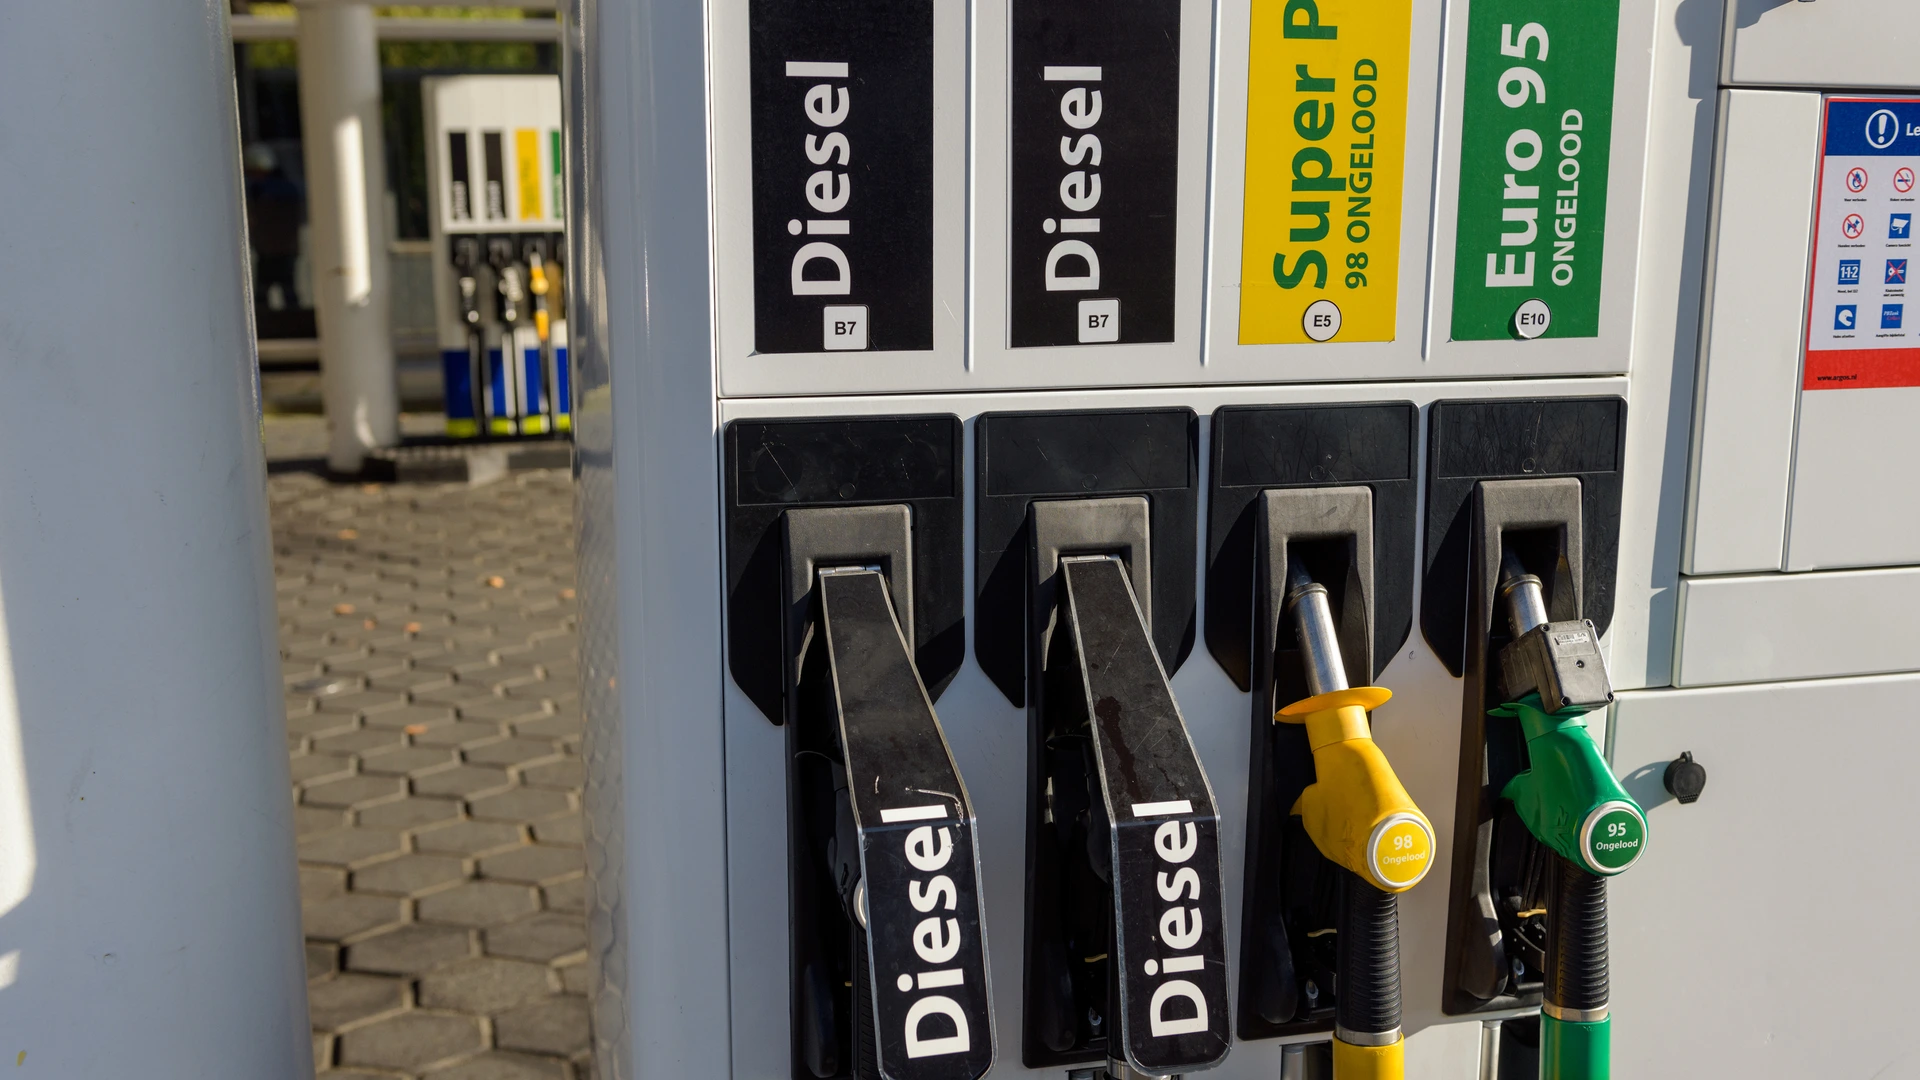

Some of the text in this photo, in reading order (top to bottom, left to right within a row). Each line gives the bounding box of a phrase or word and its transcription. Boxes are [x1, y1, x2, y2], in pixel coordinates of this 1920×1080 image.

[1485, 21, 1550, 288] Euro 95
[785, 61, 850, 296] Diesel
[1043, 65, 1102, 292] Diesel
[1273, 64, 1346, 290] Super
[1345, 58, 1378, 290] 98 ONGELOOD
[1551, 108, 1583, 287] ONGELOOD
[1088, 314, 1109, 329] B7
[1313, 314, 1332, 328] E5
[1520, 313, 1545, 326] E10
[834, 321, 857, 336] B7
[1817, 374, 1857, 382] www.argos.nl
[1607, 822, 1627, 837] 95
[1393, 835, 1413, 851] 98
[1595, 838, 1639, 852] Ongelood
[1382, 852, 1426, 866] Ongelood
[1131, 799, 1209, 1038] Diesel
[880, 803, 970, 1060] Diesel
